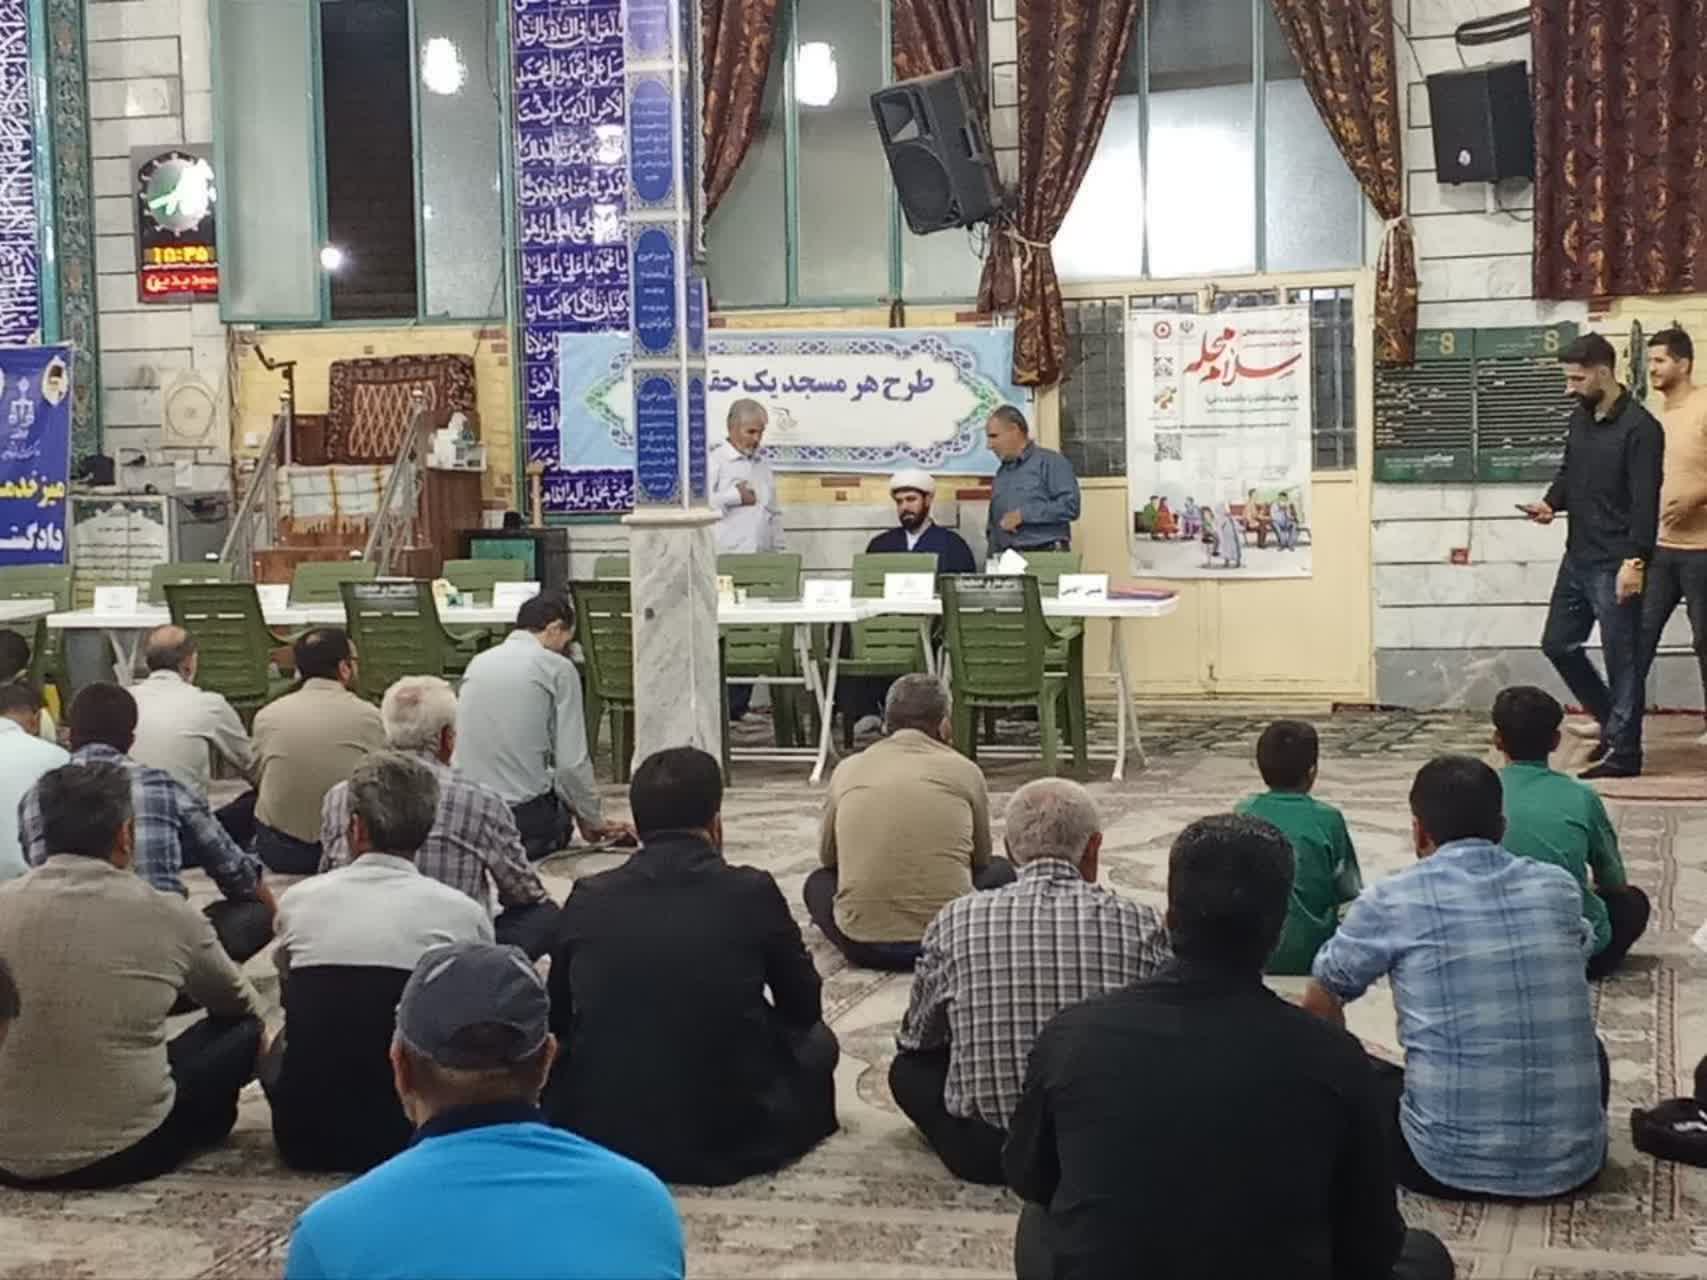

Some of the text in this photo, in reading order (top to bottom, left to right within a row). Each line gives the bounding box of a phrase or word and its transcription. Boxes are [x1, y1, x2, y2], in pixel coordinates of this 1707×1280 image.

[1183, 327, 1302, 386] سلام محله
[743, 369, 777, 398] یک
[783, 375, 847, 400] مسجد
[849, 375, 879, 402] هر
[882, 368, 935, 402] طرح
[0, 469, 38, 499] خدم
